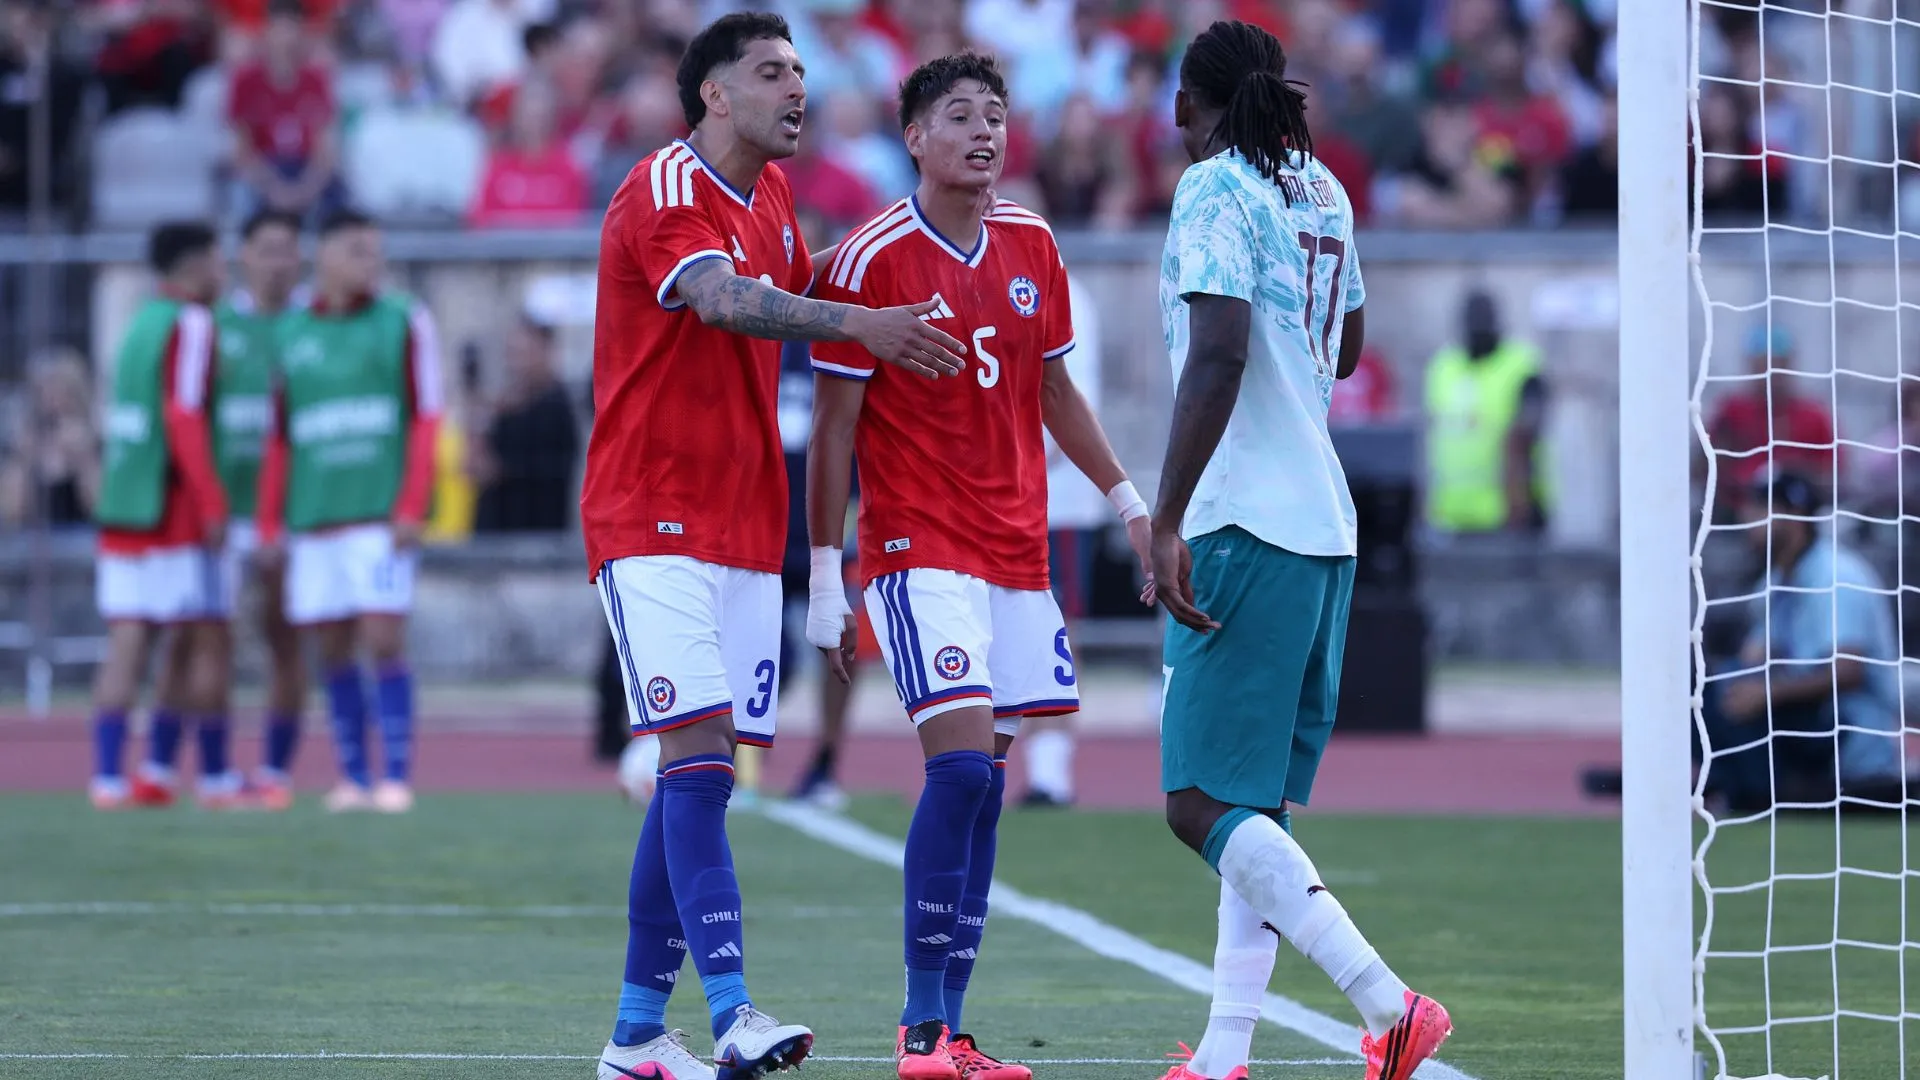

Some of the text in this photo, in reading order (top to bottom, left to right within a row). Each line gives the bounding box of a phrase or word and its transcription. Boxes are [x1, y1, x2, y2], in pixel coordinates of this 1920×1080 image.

[972, 325, 1000, 389] 5
[746, 659, 775, 718] 3
[917, 899, 954, 913] CHILE
[701, 911, 740, 924] CHILE
[957, 914, 986, 927] CHIL
